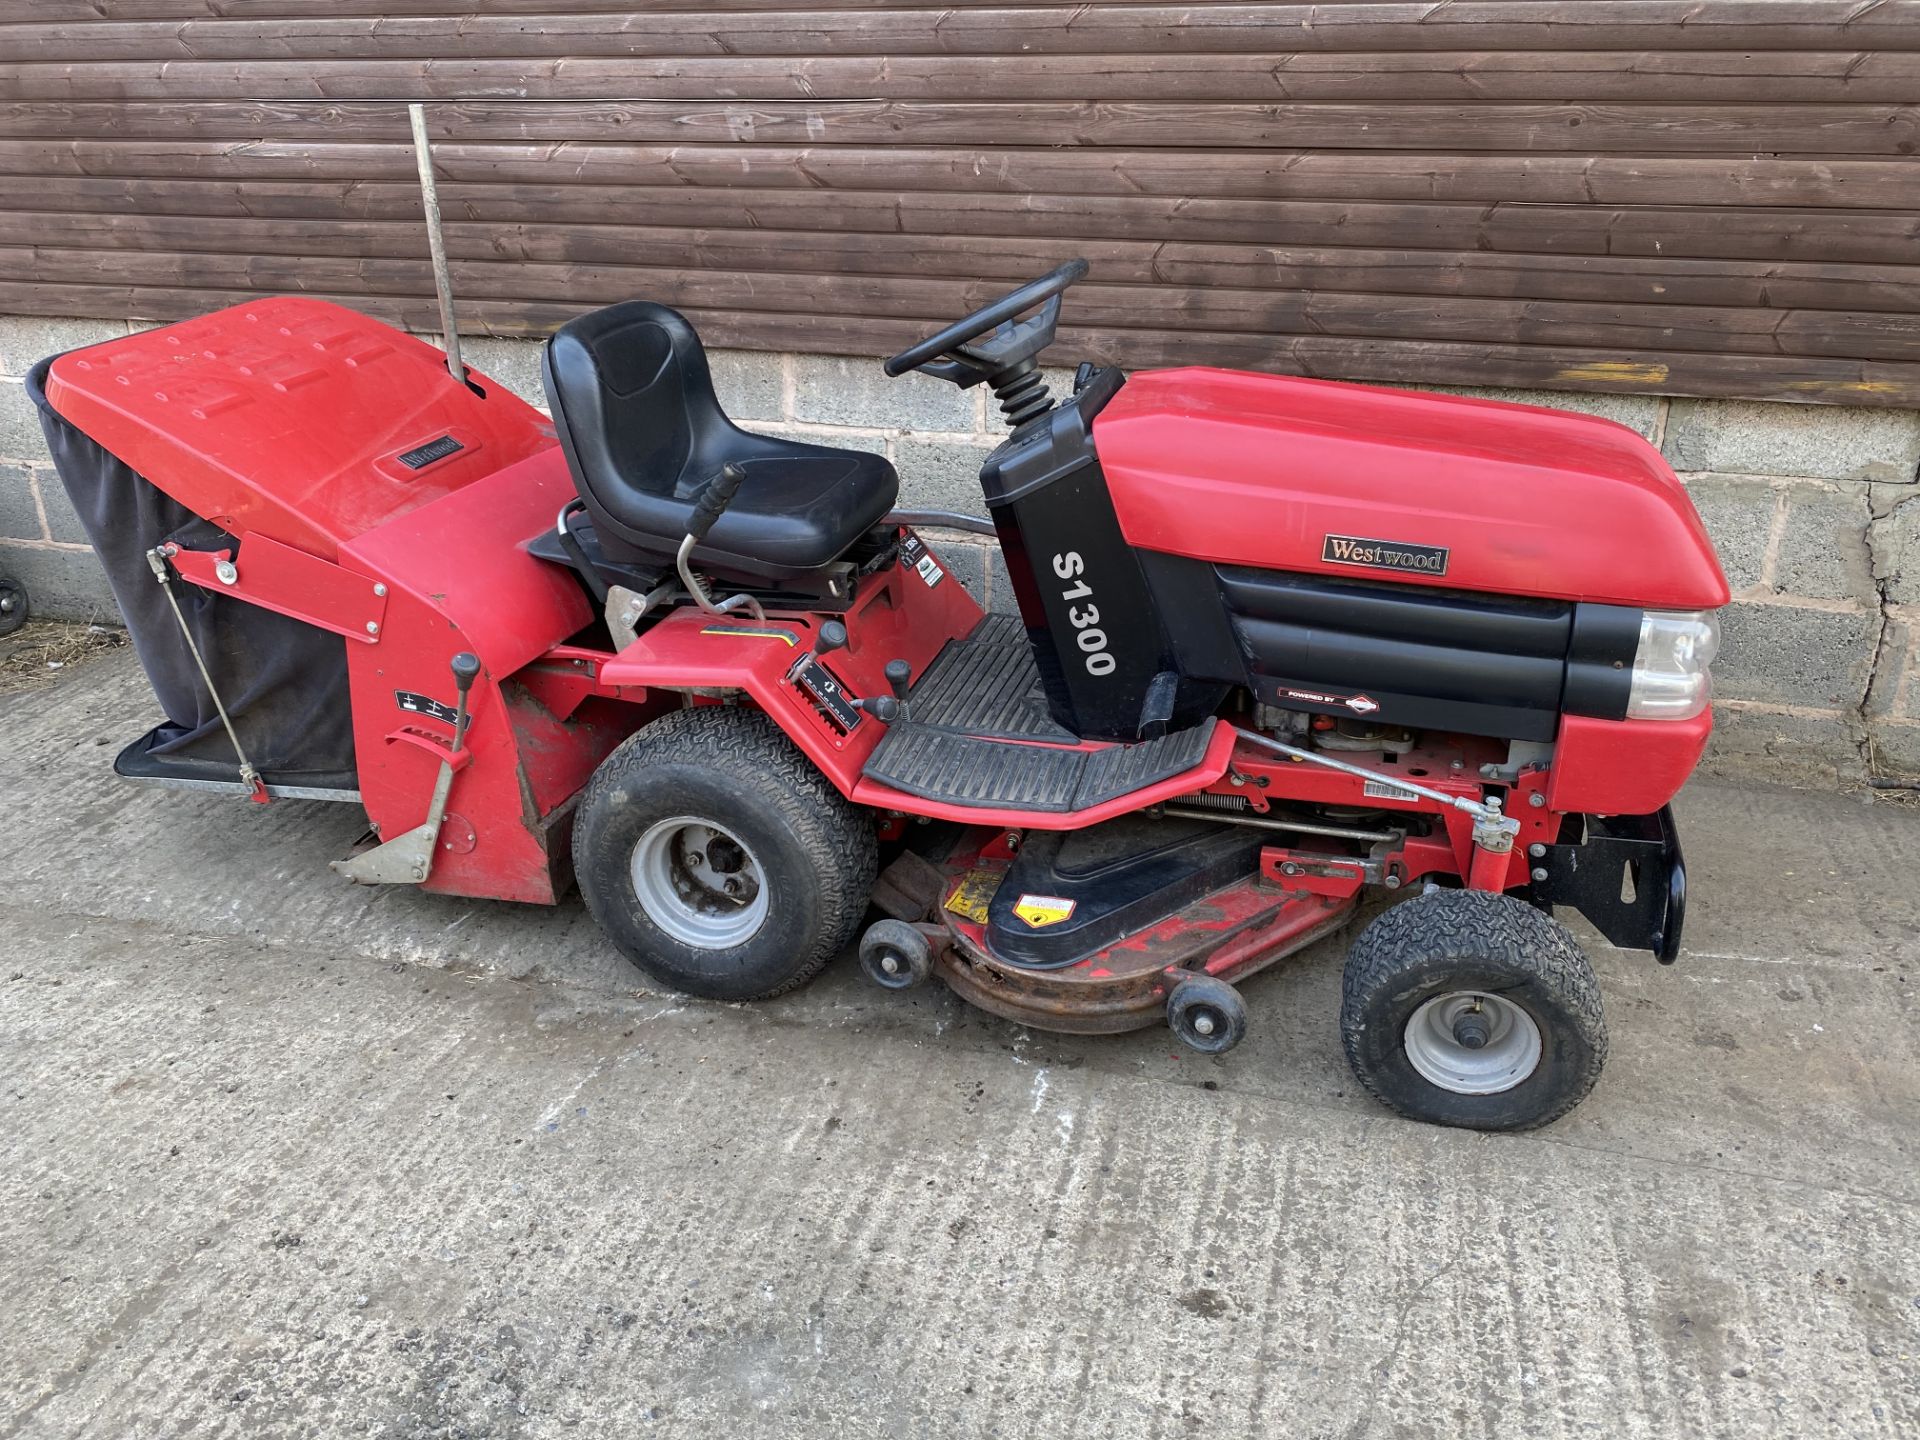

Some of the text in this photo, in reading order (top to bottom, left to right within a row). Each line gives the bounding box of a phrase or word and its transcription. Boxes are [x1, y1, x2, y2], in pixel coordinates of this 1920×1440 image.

[1331, 539, 1442, 570] Westwood
[1052, 551, 1116, 676] S1300
[1288, 690, 1324, 701] POWERED
